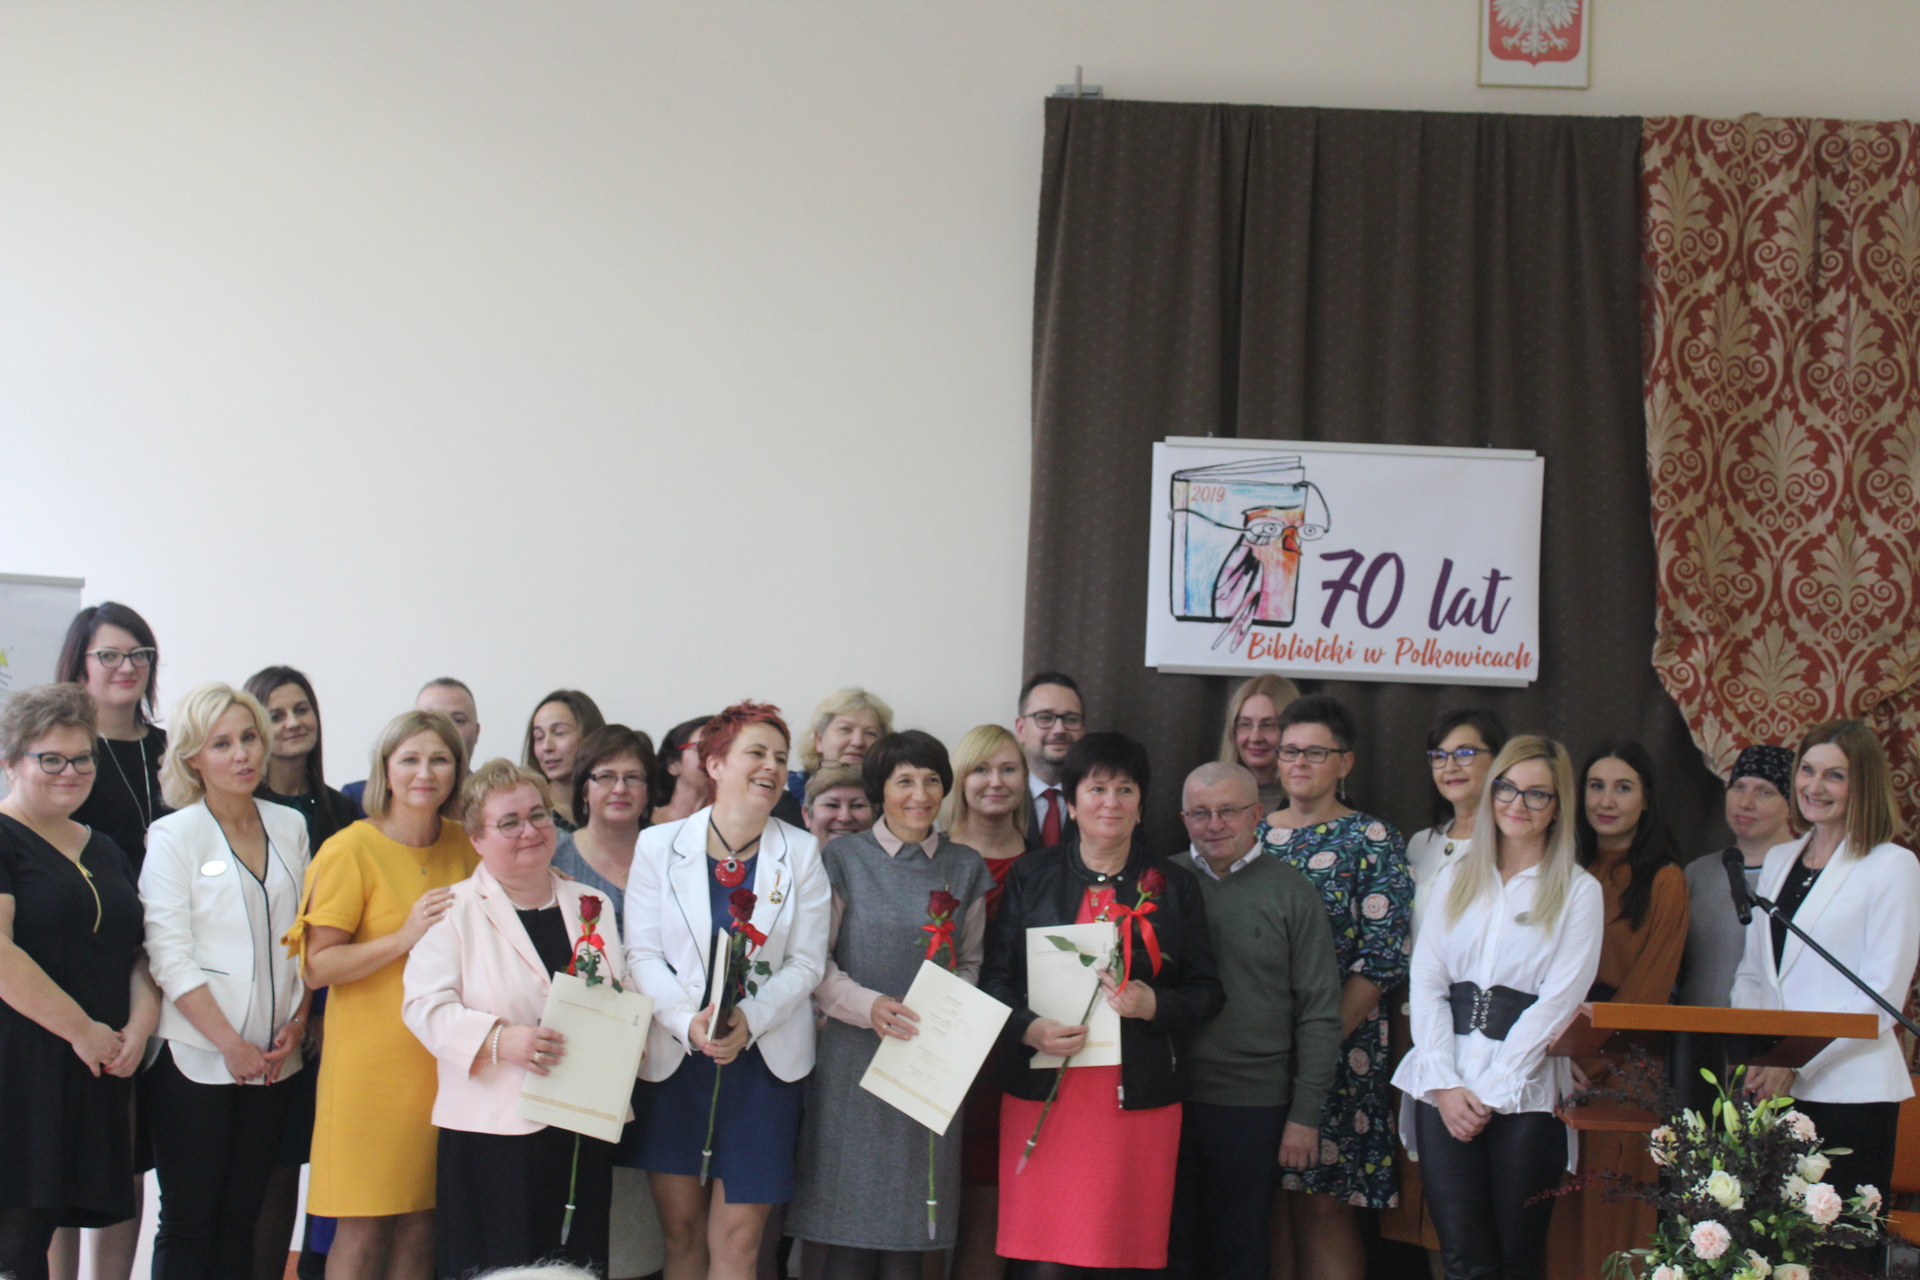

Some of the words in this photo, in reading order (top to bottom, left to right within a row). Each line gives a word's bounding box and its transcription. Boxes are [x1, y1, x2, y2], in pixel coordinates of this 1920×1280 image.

[1191, 485, 1227, 503] 2019
[1320, 549, 1405, 629] 70
[1428, 557, 1513, 634] lat
[1247, 632, 1357, 664] Biblioteki
[1363, 647, 1387, 664] w
[1395, 637, 1533, 669] Polkowicach
